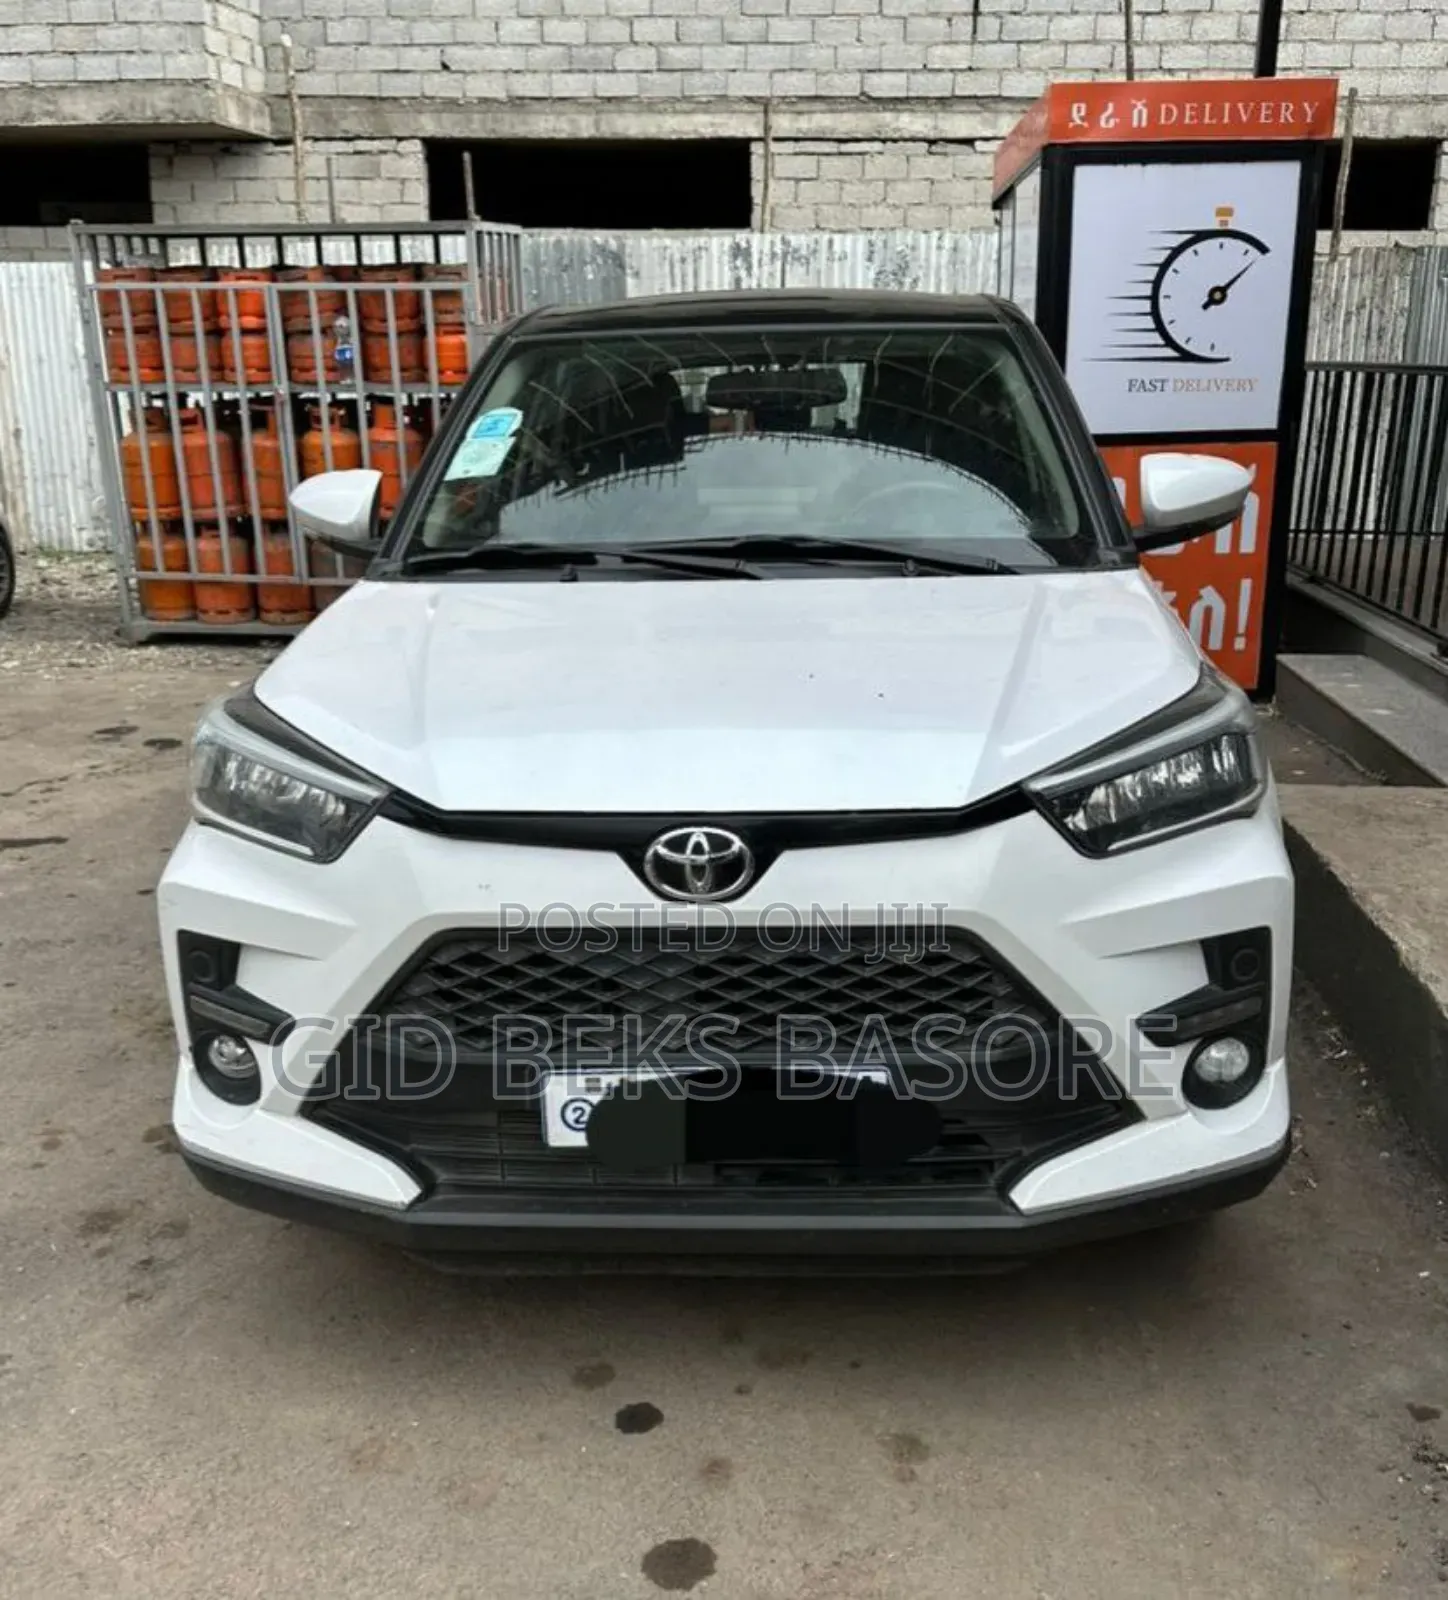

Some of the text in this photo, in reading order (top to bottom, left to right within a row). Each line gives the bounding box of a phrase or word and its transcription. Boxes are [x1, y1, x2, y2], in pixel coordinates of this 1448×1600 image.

[1159, 101, 1319, 125] DELIVERY
[1126, 377, 1258, 393] FAST DELIVERY
